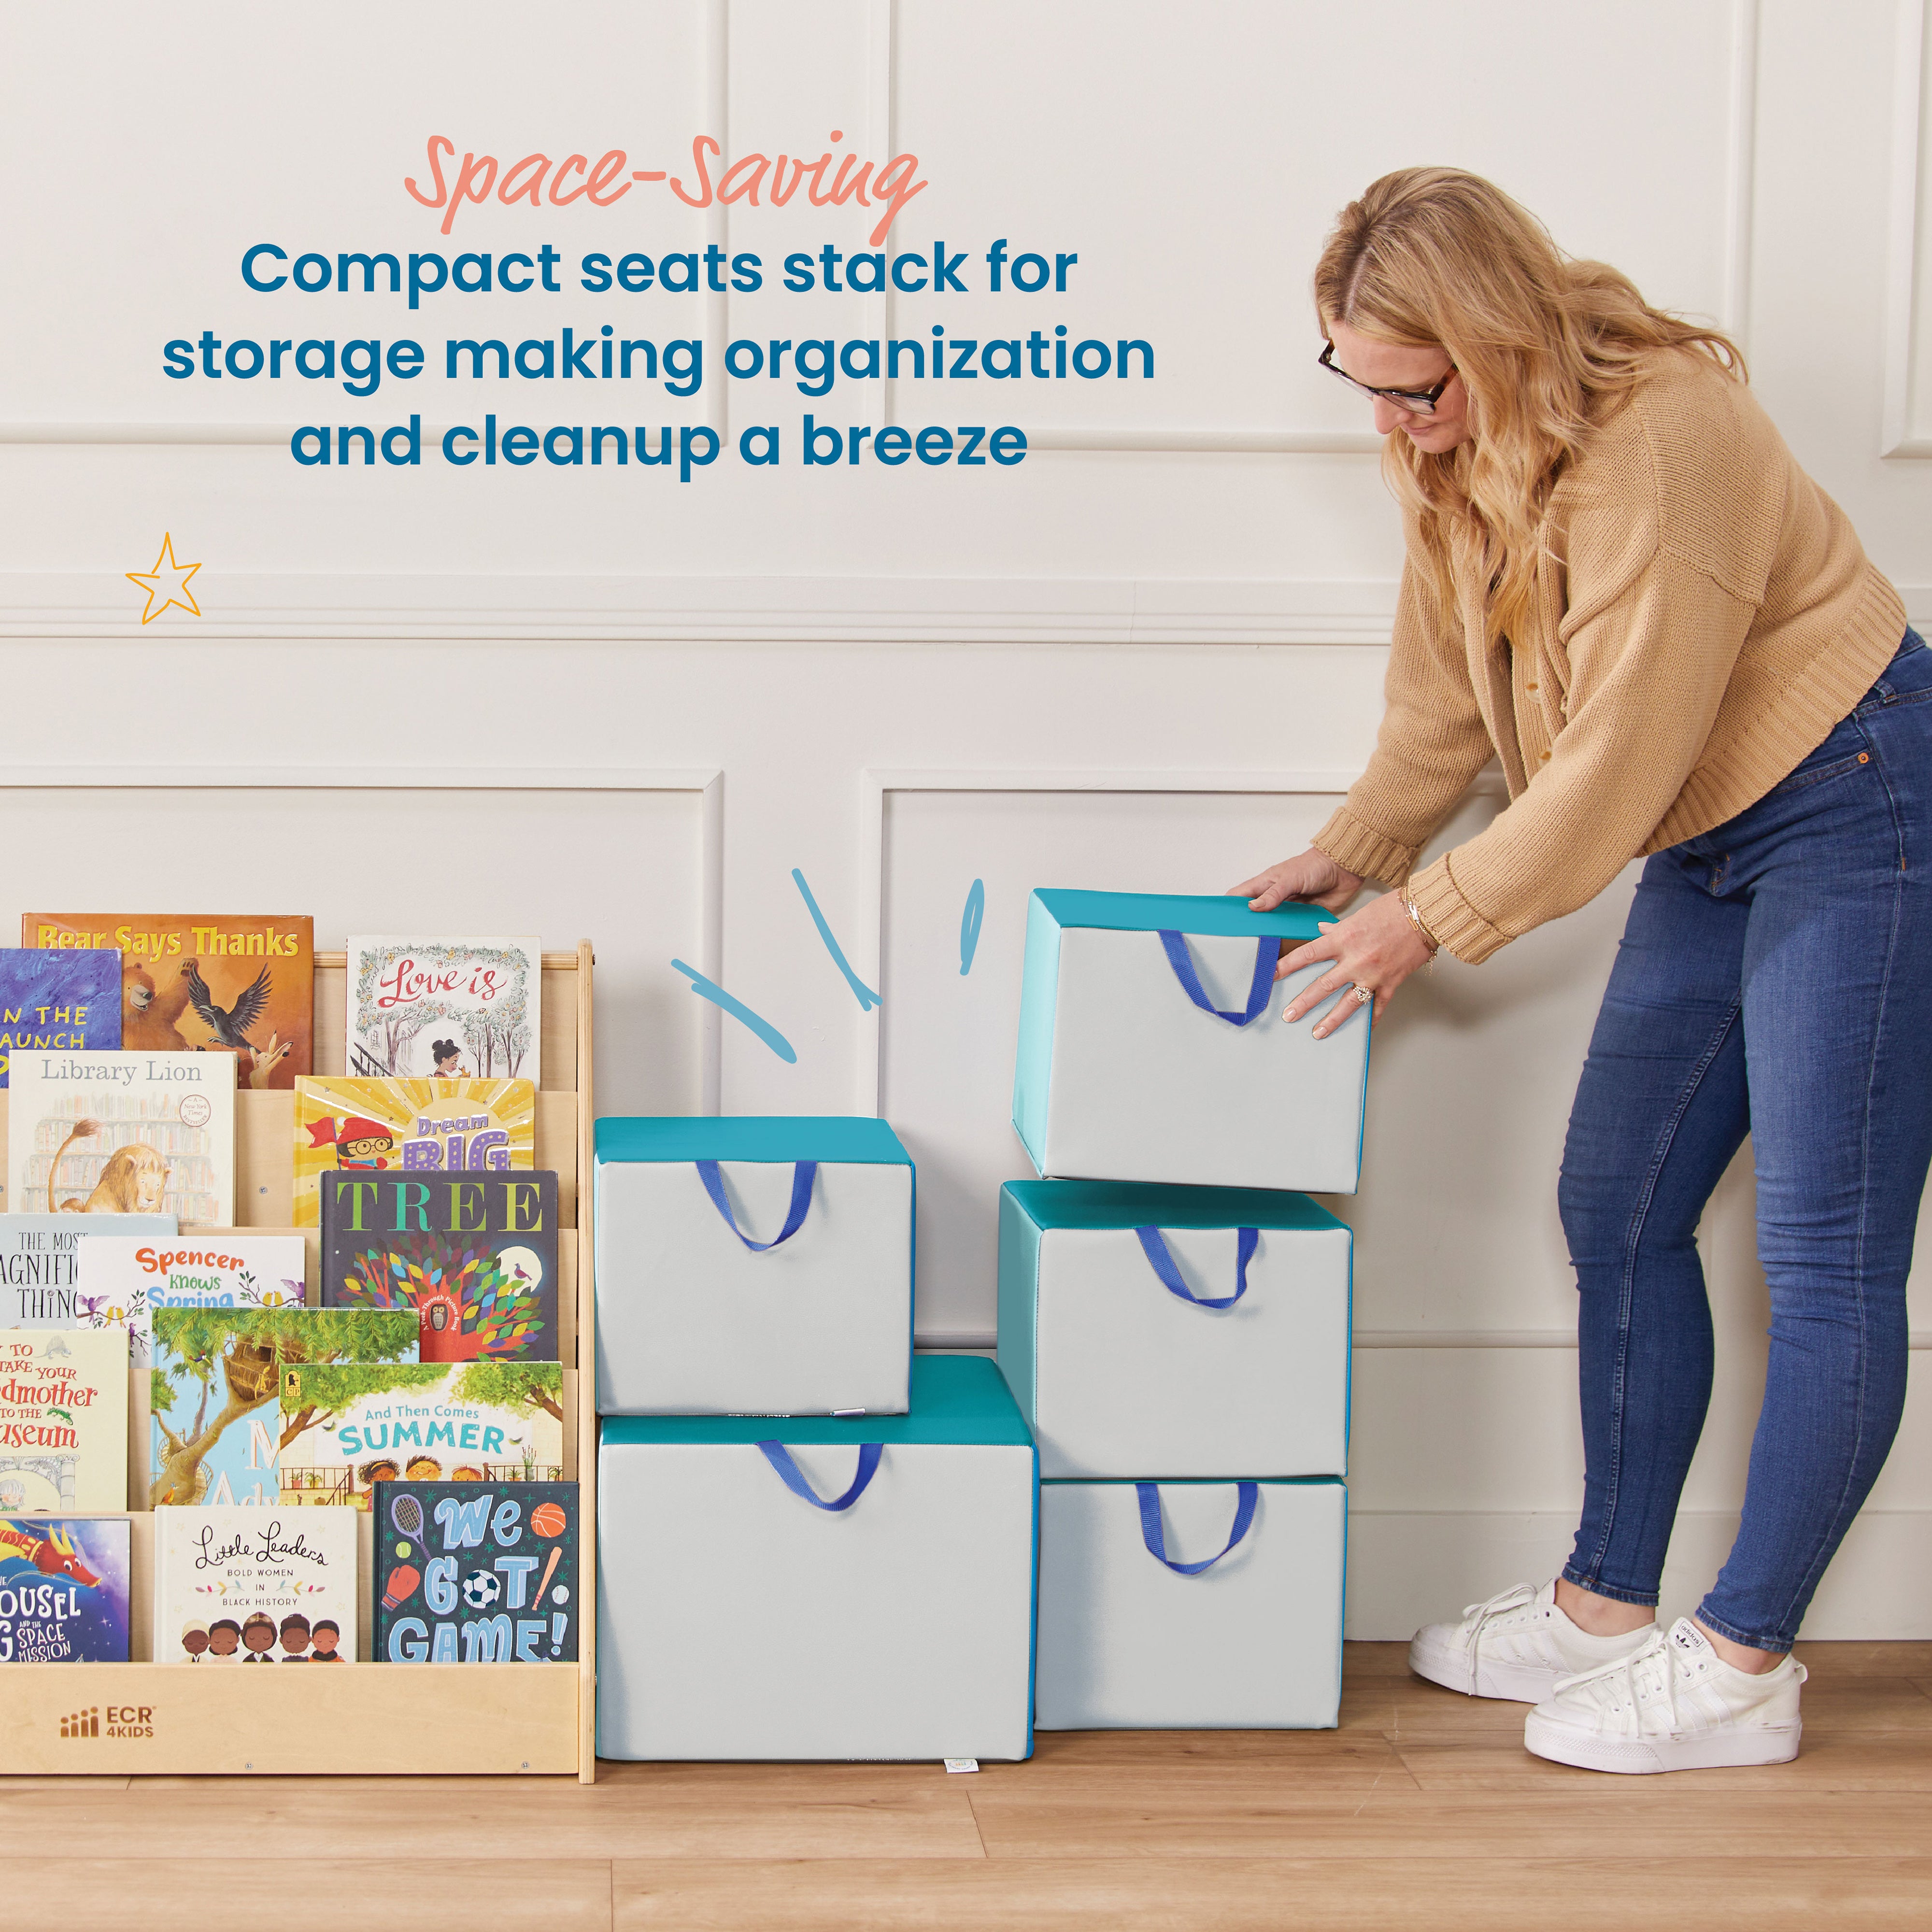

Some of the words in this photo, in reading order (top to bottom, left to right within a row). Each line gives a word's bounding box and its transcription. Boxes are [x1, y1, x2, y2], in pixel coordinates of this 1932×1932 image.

[38, 925, 107, 949] Bear
[114, 925, 182, 963] Says
[191, 926, 299, 957] Thanks
[378, 959, 468, 1008] Love
[469, 966, 507, 1000] is
[35, 1006, 88, 1025] THE
[41, 1059, 137, 1086] Library
[146, 1061, 202, 1080] Lion
[417, 1113, 488, 1136] Dream
[400, 1128, 511, 1171] BIG
[337, 1182, 542, 1232] TREE
[18, 1232, 45, 1250] THE
[53, 1232, 88, 1250] MOS
[135, 1247, 244, 1275] Spencer
[445, 1296, 458, 1315] Picture
[450, 1317, 460, 1331] Book
[10, 1344, 33, 1356] TO
[0, 1360, 32, 1373] TAKE
[18, 1408, 42, 1419] THE
[365, 1406, 391, 1421] And
[396, 1405, 429, 1417] Then
[434, 1405, 479, 1419] Comes
[338, 1421, 504, 1455] SUMMER
[192, 1525, 254, 1569] Little
[256, 1521, 329, 1565] Leaders
[16, 1623, 66, 1648] SPACE
[1681, 1626, 1699, 1644] adidas
[18, 1641, 71, 1662] MISSION
[107, 1706, 152, 1723] ECR
[107, 1726, 154, 1737] 4KIDS
